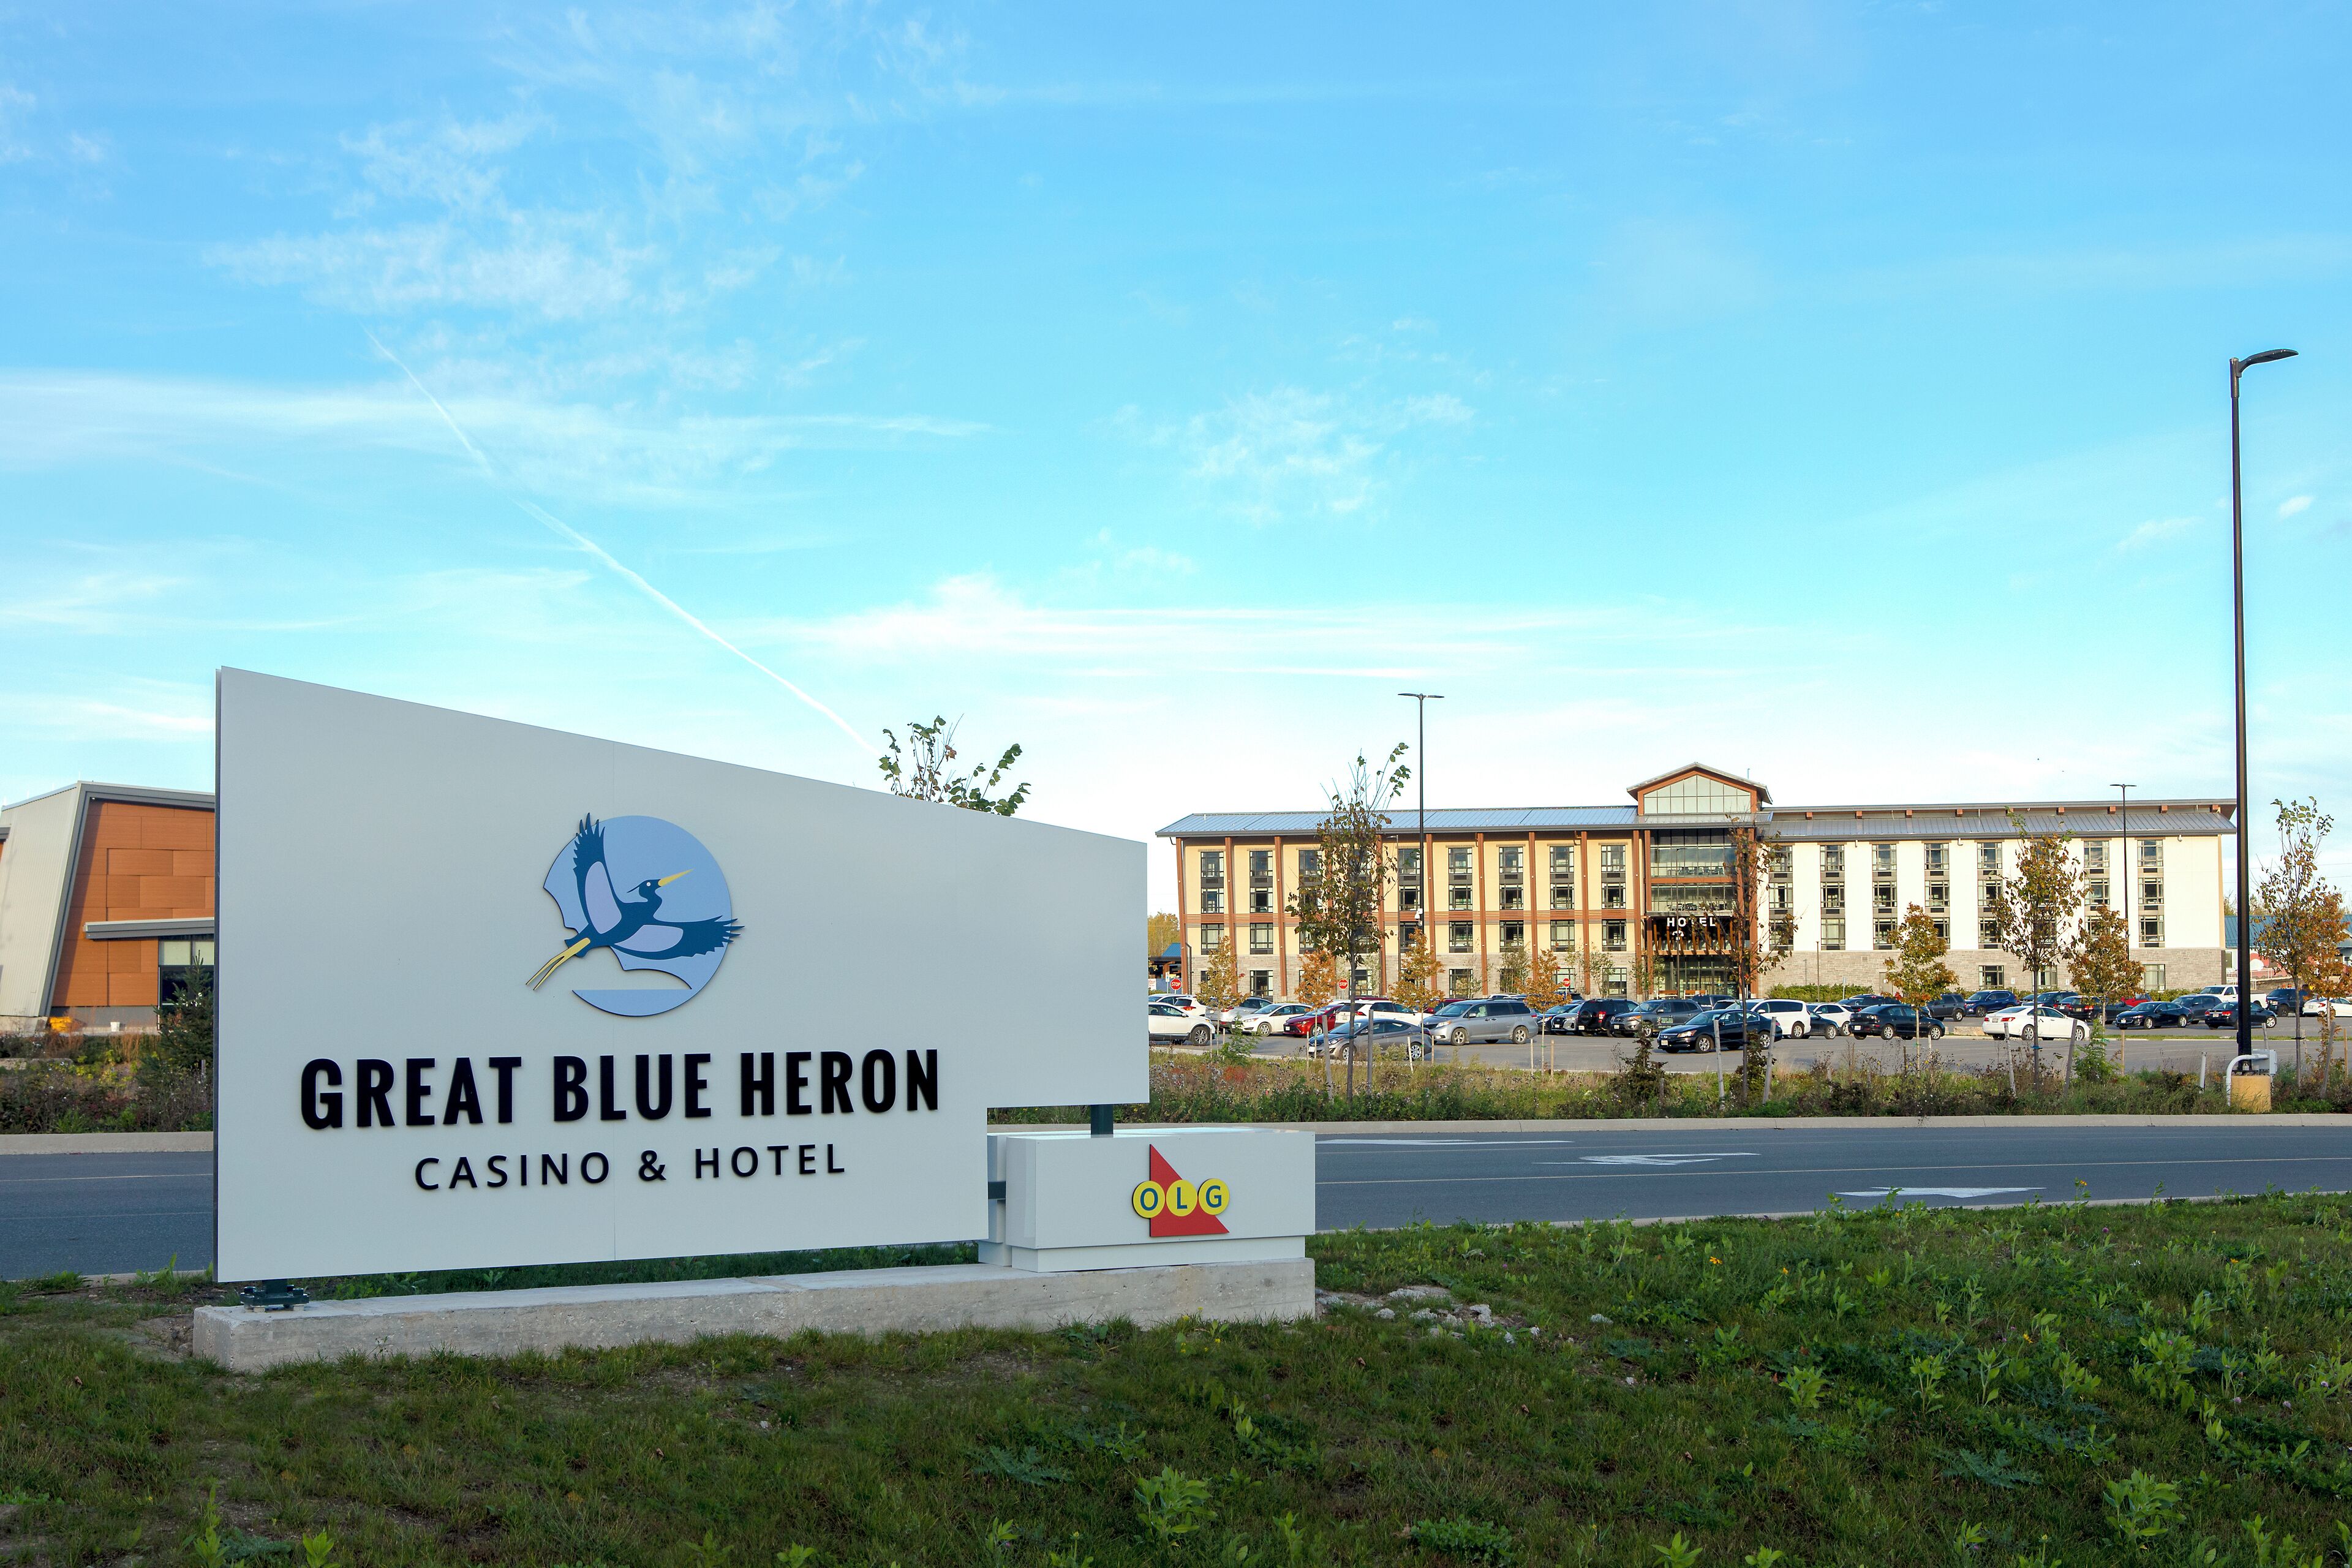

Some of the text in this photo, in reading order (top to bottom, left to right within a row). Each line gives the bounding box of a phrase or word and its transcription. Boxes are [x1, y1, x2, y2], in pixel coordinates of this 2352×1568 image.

[300, 1049, 938, 1131] GREAT BLUE HERON
[414, 1143, 845, 1191] CASINO & HOTEL
[1140, 1185, 1223, 1212] OLG
